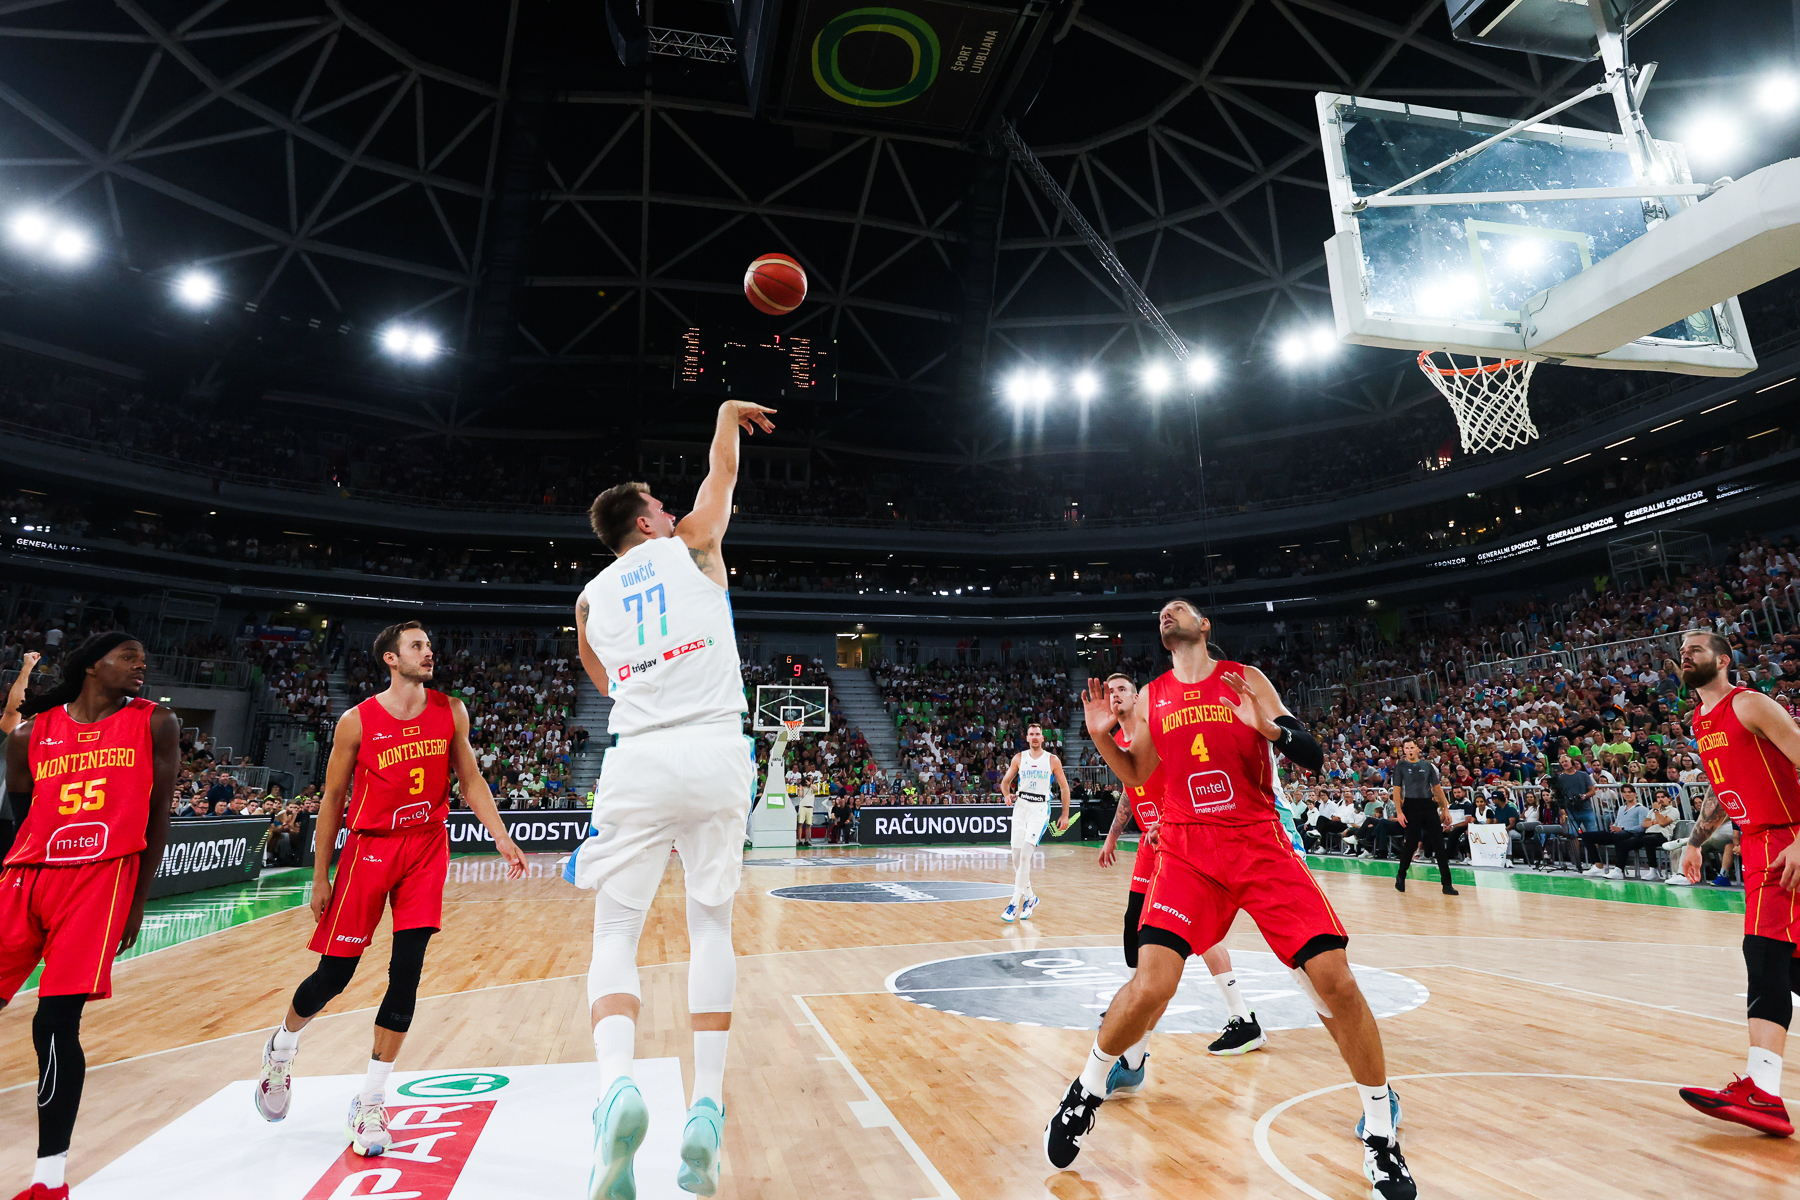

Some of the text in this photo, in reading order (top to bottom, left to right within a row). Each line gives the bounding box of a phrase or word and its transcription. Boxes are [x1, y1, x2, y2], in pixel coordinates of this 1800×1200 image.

[950, 45, 972, 72] ŠPORT
[970, 31, 998, 74] LJUBLJANA
[1624, 501, 1666, 519] GENERALNI
[1666, 490, 1704, 508] SPONZOR
[1546, 525, 1582, 542] GENERALNI
[1582, 516, 1614, 532] SPONZOR
[16, 538, 69, 550] GENERALNI
[1478, 546, 1510, 560] GENERALNI
[1510, 538, 1538, 552] SPONZOR
[620, 560, 656, 588] DONČIĆ
[622, 582, 668, 646] 77
[672, 640, 706, 657] SPAR
[786, 656, 792, 664] 6
[632, 658, 657, 673] triglav
[794, 664, 802, 677] 9
[1162, 705, 1233, 734] MONTENEGRO
[377, 739, 447, 770] MONTENEGRO
[1190, 733, 1210, 762] 4
[35, 748, 135, 781] MONTENEGRO
[1021, 770, 1048, 780] SLOVENIJA
[1708, 758, 1725, 784] 11
[409, 767, 424, 795] 3
[1196, 780, 1226, 796] m:tel
[58, 778, 106, 816] 55
[56, 833, 98, 850] m:tel
[154, 838, 246, 878] NOVODSTVO
